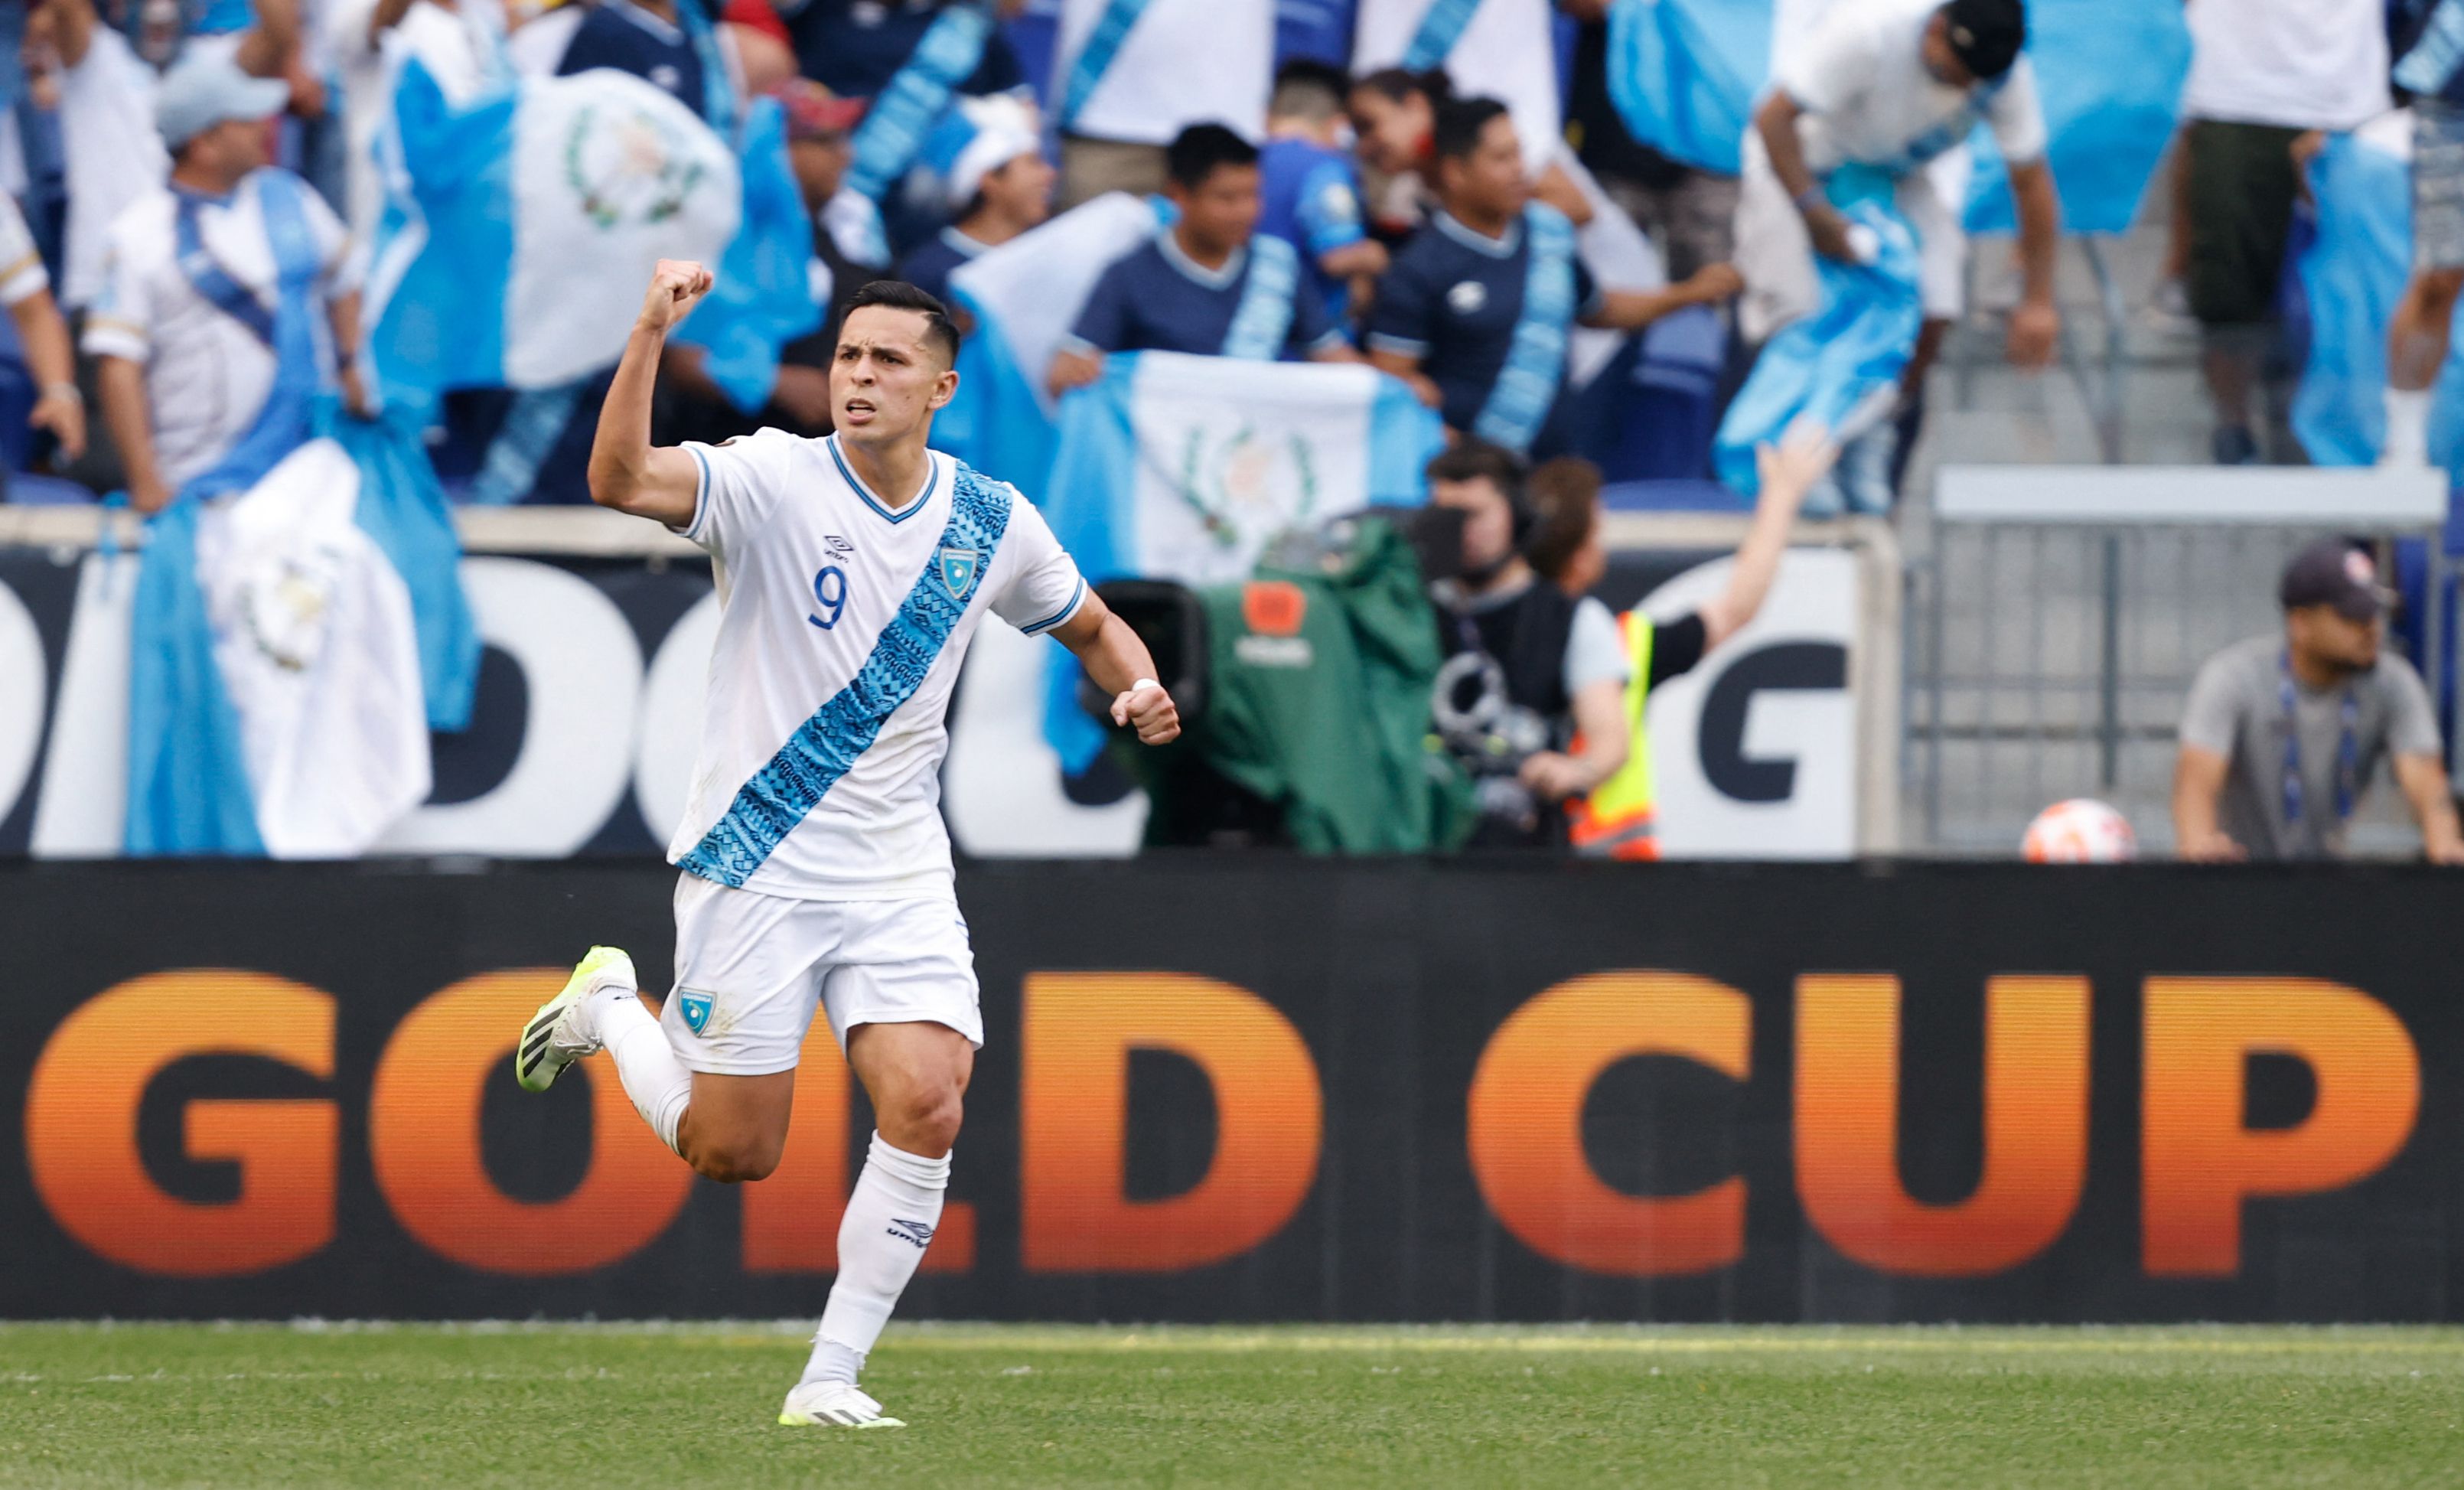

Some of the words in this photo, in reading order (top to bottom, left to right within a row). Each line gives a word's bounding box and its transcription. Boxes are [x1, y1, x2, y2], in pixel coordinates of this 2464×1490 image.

[808, 566, 846, 631] 9
[25, 968, 1322, 1274] GOLD
[1467, 969, 2420, 1276] CUP
